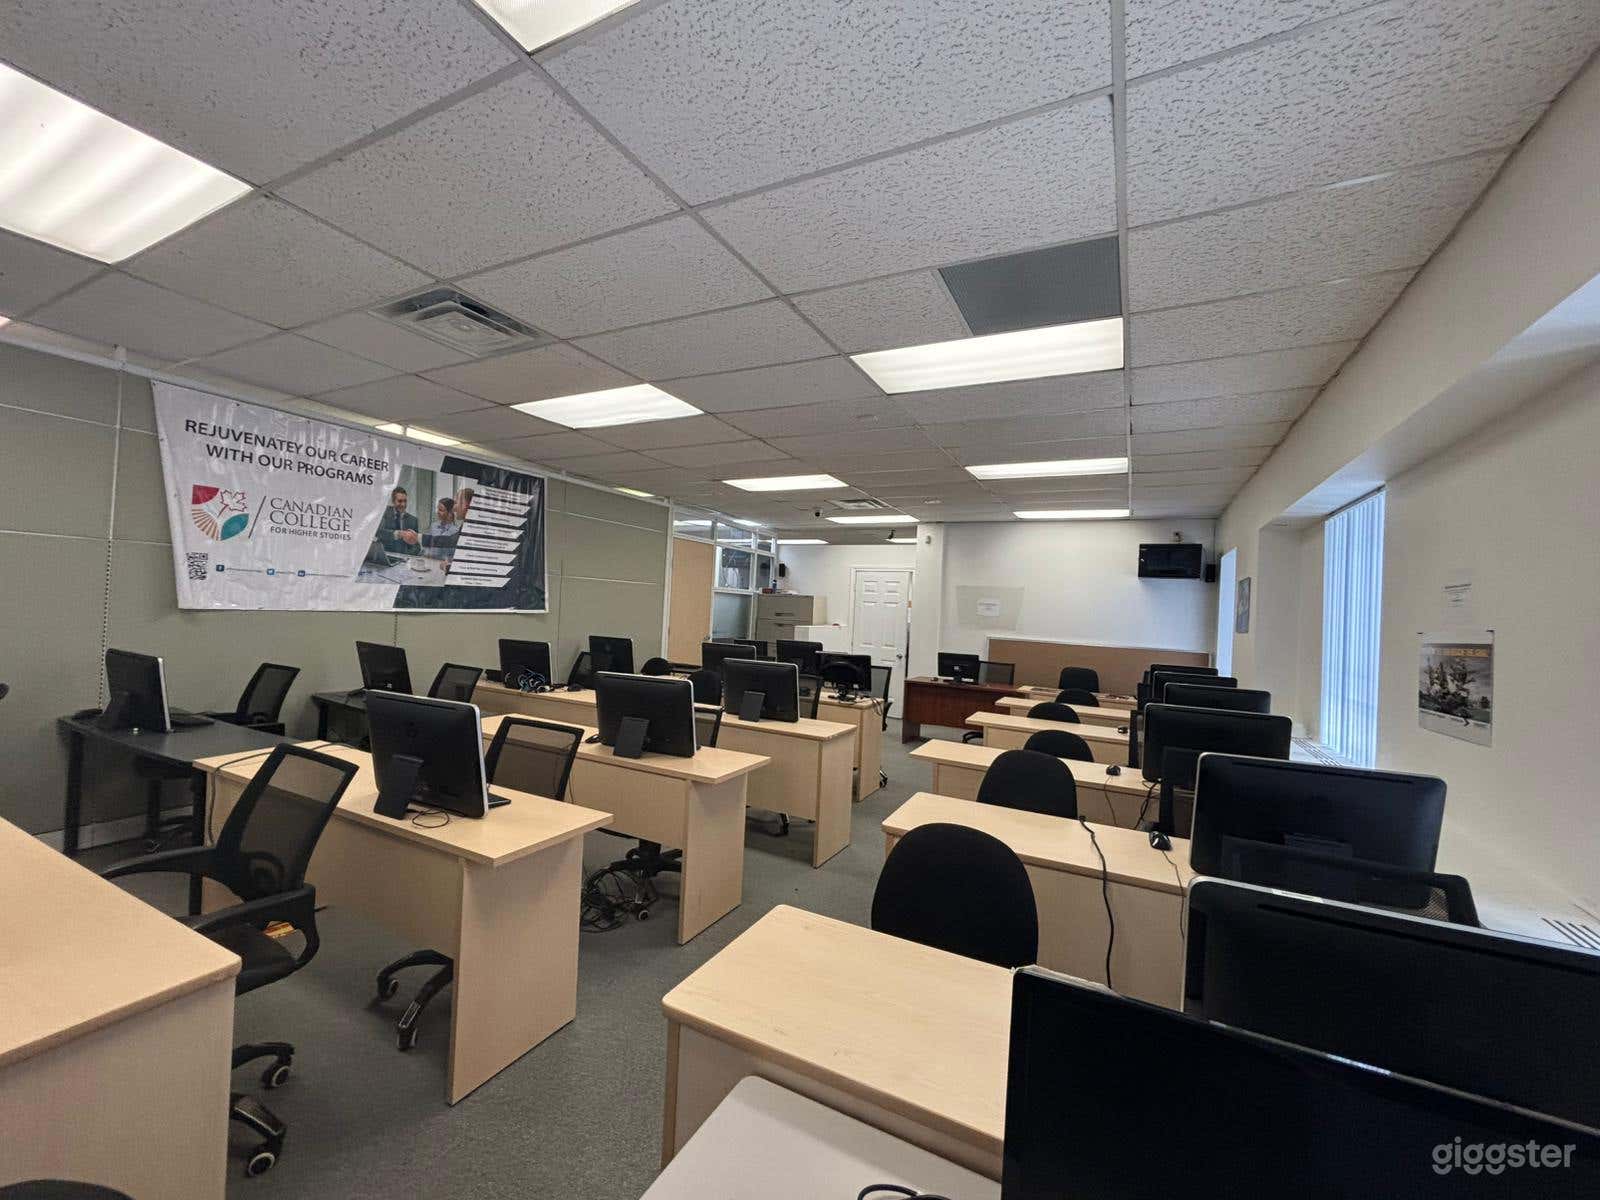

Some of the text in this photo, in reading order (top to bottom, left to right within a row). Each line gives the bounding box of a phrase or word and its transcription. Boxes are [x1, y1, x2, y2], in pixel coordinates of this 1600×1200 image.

[206, 444, 374, 486] WITH OUR PROGRAMS
[340, 452, 389, 472] CAREER
[270, 497, 353, 519] CANADIAN
[269, 509, 351, 532] COLLEGE
[270, 525, 352, 541] FOR HIGHER STUDIES
